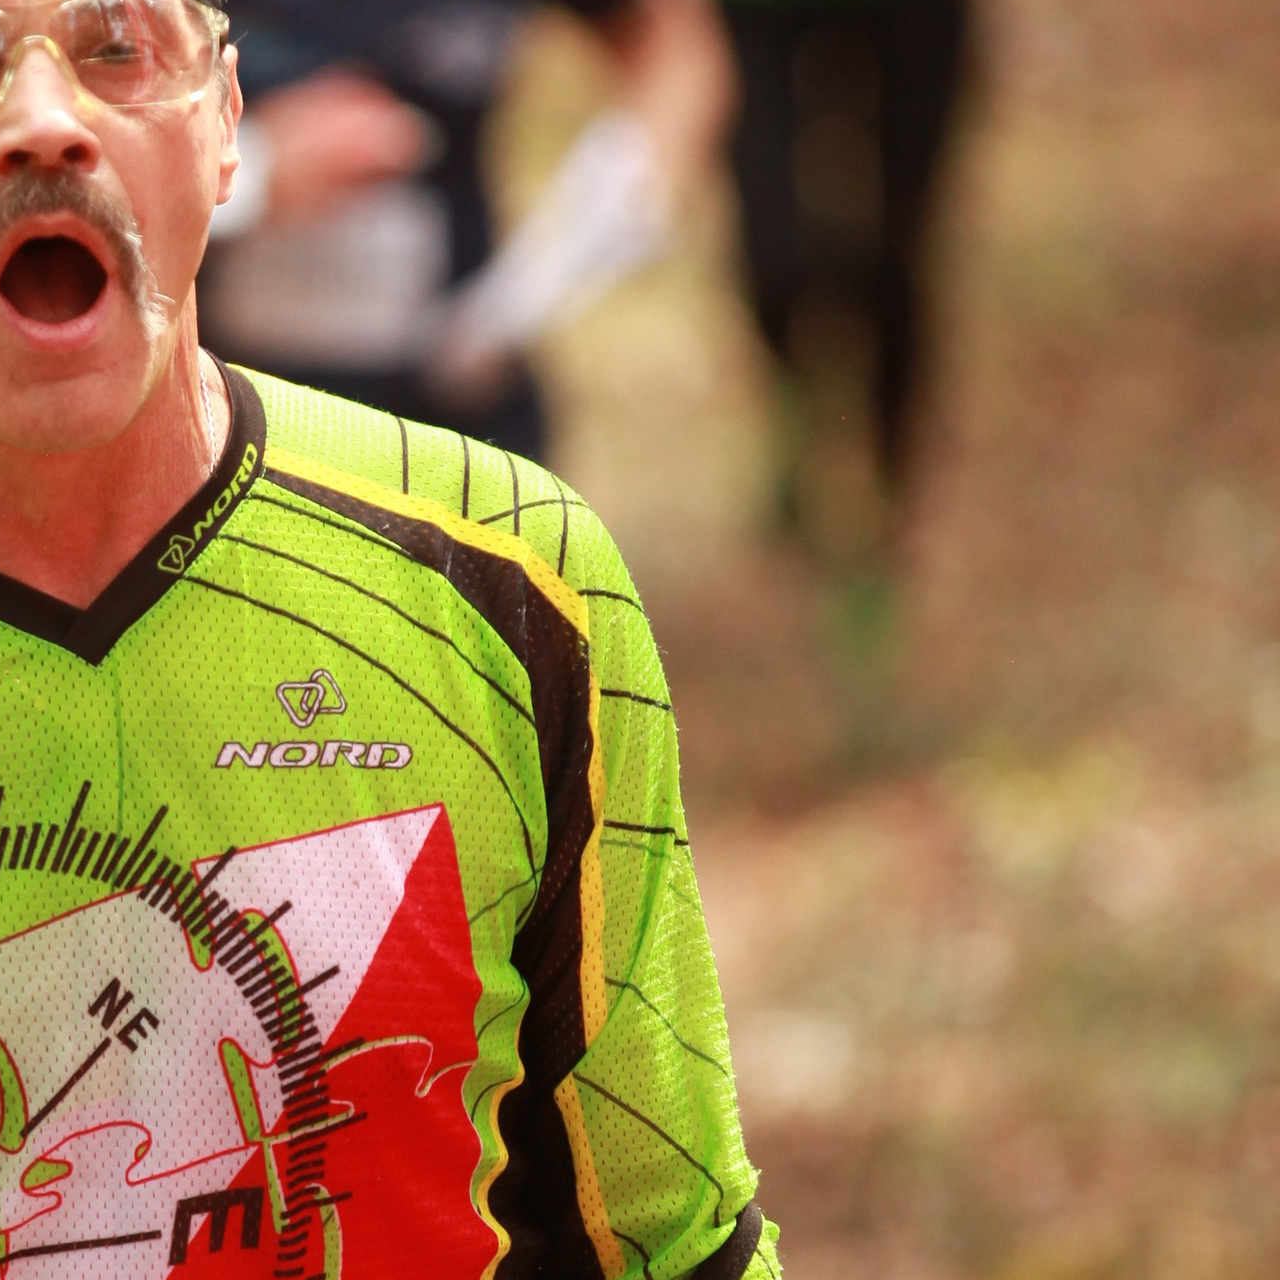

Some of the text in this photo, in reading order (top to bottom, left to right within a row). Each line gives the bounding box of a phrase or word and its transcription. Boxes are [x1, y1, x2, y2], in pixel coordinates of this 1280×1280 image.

[192, 442, 258, 541] NORD
[215, 740, 413, 769] NORD
[87, 977, 160, 1053] NE
[168, 1186, 264, 1266] E
